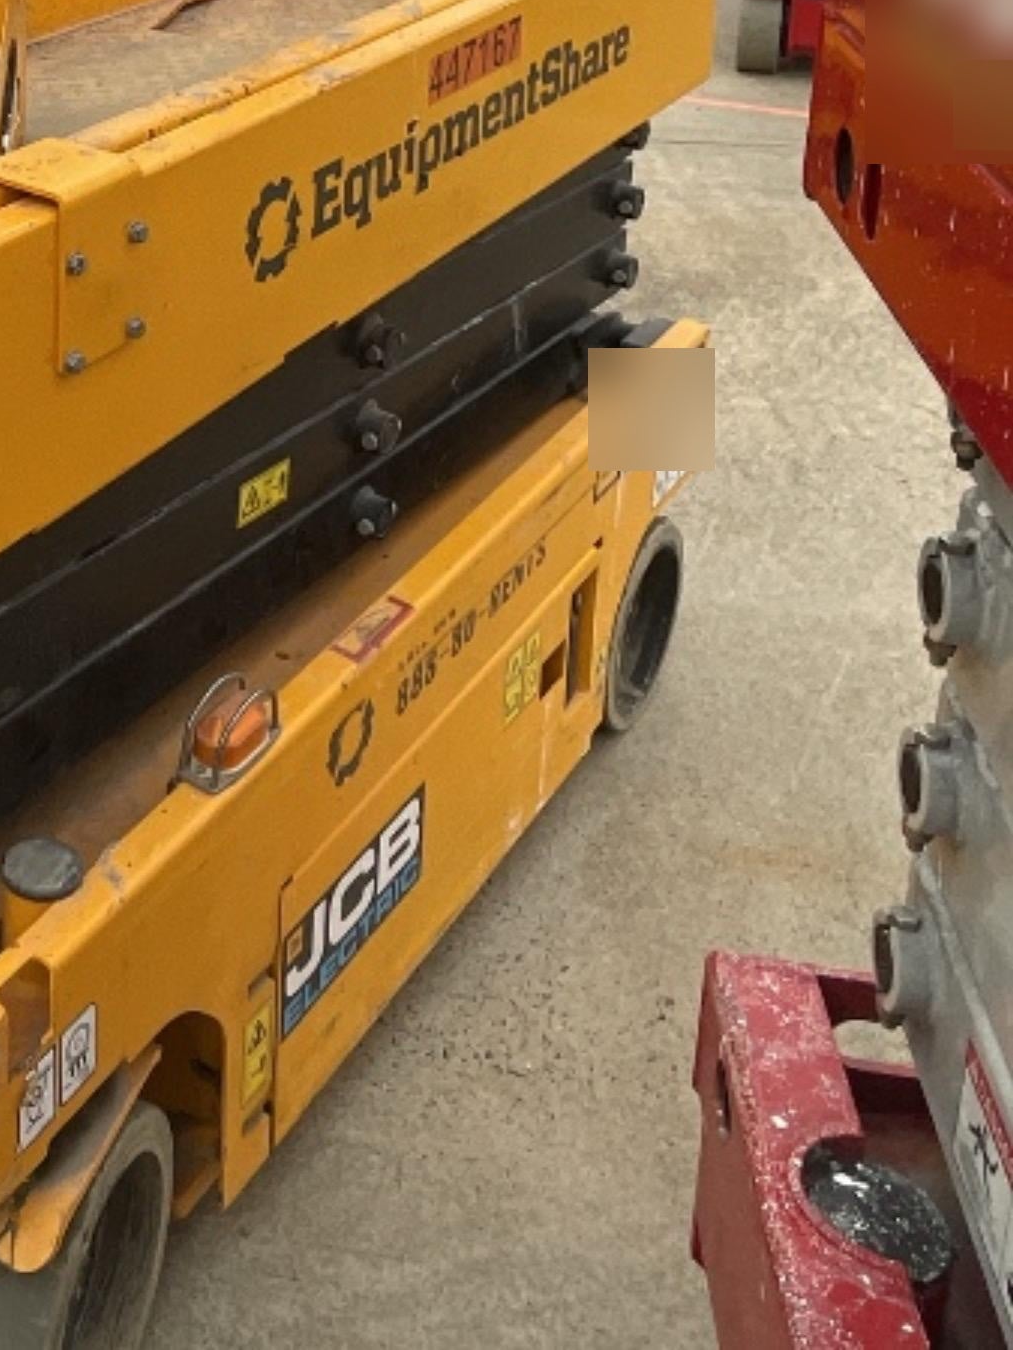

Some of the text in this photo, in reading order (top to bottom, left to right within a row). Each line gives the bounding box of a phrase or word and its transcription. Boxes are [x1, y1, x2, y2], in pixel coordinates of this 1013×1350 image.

[311, 25, 630, 240] EquipmentShare
[429, 16, 522, 98] 447167
[283, 857, 421, 1036] ELECTRIC
[286, 796, 421, 997] JCB
